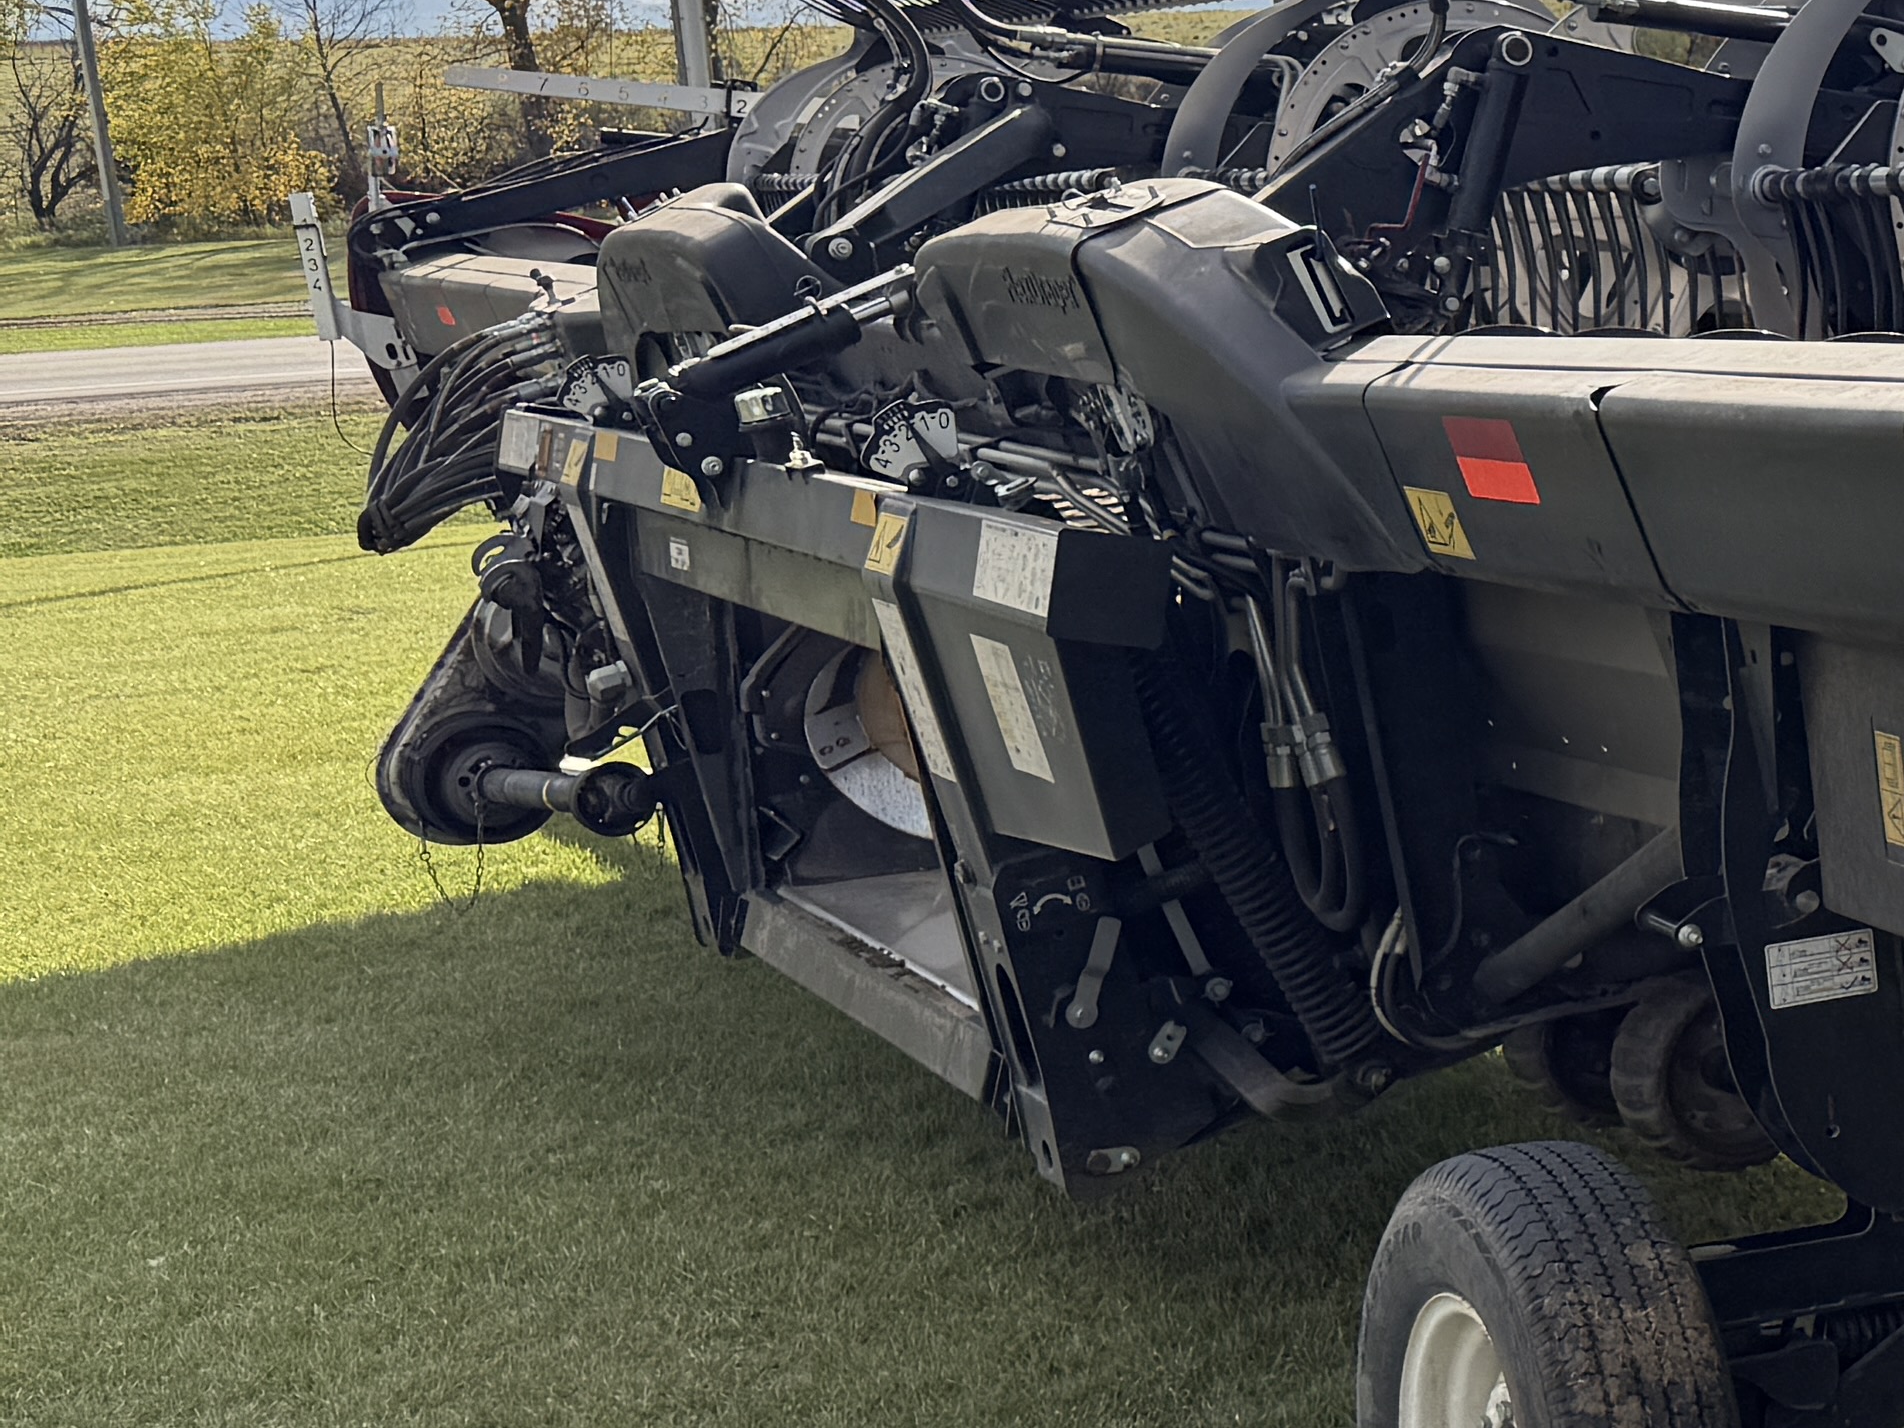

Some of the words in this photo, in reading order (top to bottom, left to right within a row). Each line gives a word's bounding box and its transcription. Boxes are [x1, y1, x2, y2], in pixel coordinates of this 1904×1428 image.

[618, 86, 629, 101] 5
[736, 99, 748, 114] 2
[303, 238, 315, 252] 2
[308, 258, 319, 272] 3
